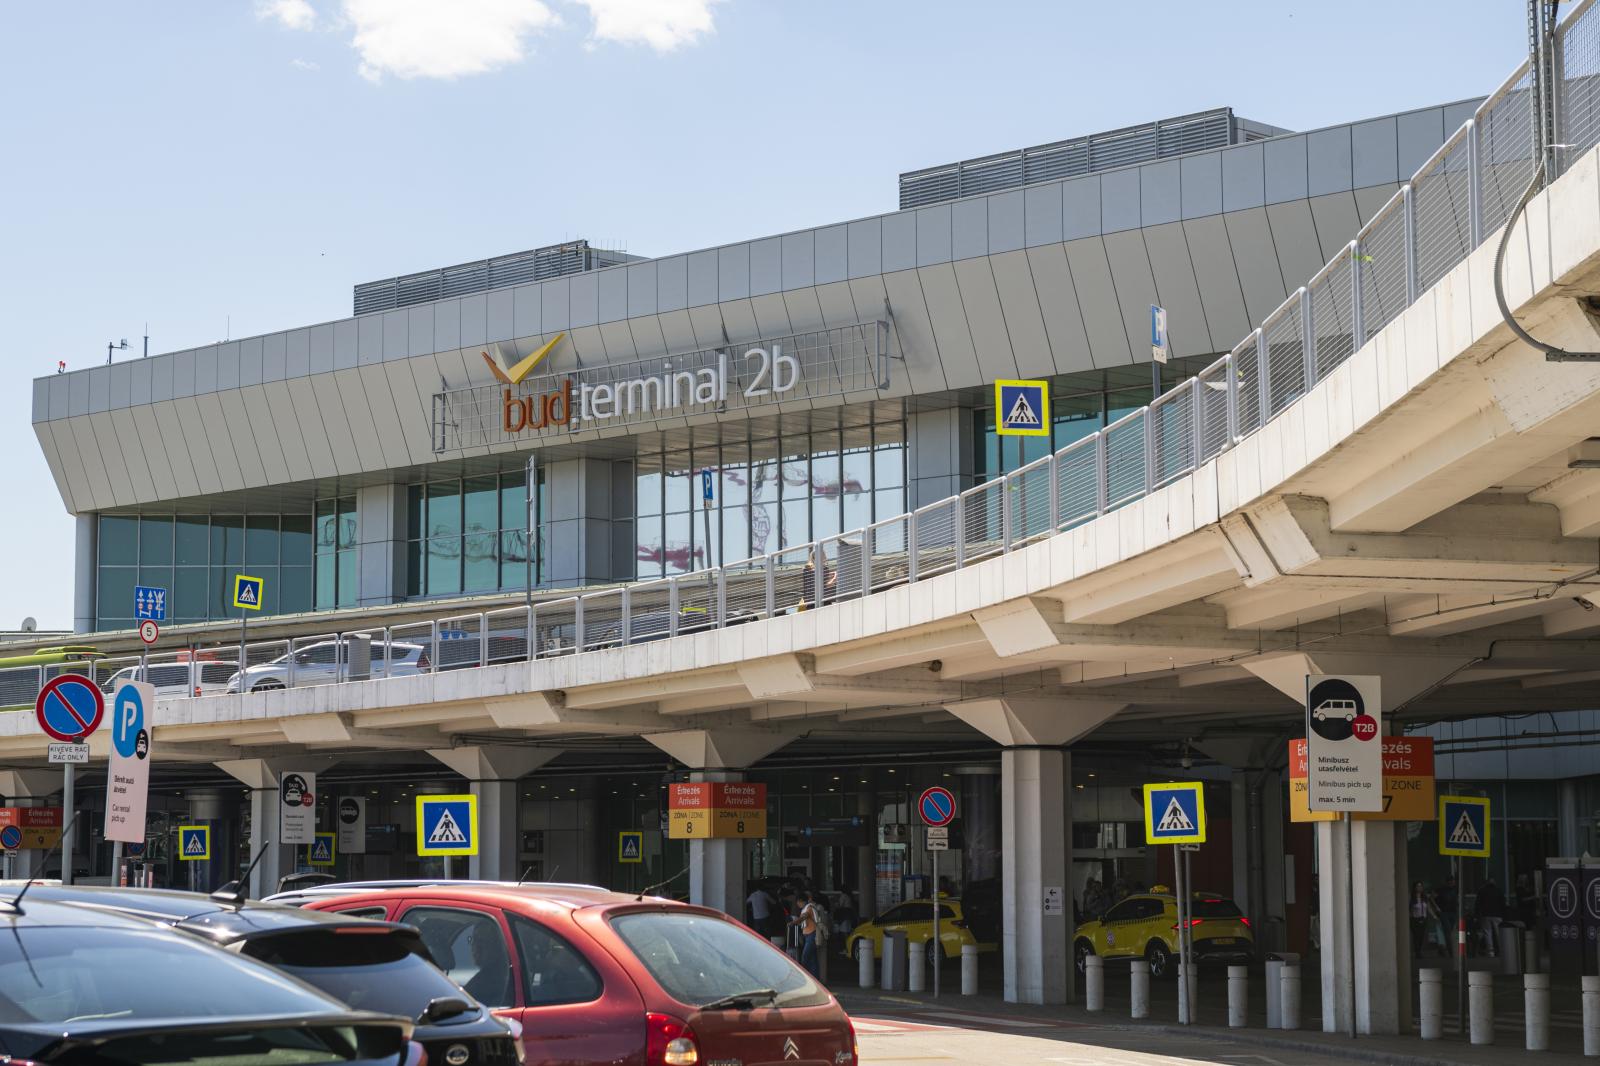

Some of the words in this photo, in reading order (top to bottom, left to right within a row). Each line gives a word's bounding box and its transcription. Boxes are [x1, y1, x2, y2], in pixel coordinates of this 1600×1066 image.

[744, 345, 800, 397] 2b
[705, 474, 711, 496] P
[146, 626, 153, 637] 5
[121, 701, 137, 742] P
[1356, 723, 1375, 733] T2B
[1381, 742, 1412, 754] ezés
[1318, 756, 1349, 764] Minibusz
[1318, 765, 1359, 773] utasfelvétel
[677, 784, 701, 795] Érkezés
[724, 784, 756, 795] Érkezés
[1295, 781, 1309, 792] ZÓN
[1347, 781, 1361, 789] pick
[1391, 780, 1422, 791] ZONE
[678, 796, 700, 805] Arrivals
[725, 796, 755, 805] Arrivals
[1382, 796, 1393, 813] 7
[720, 810, 738, 818] ZÓNA
[686, 821, 693, 833] 8
[737, 821, 745, 833] 8
[38, 835, 44, 845] 9
